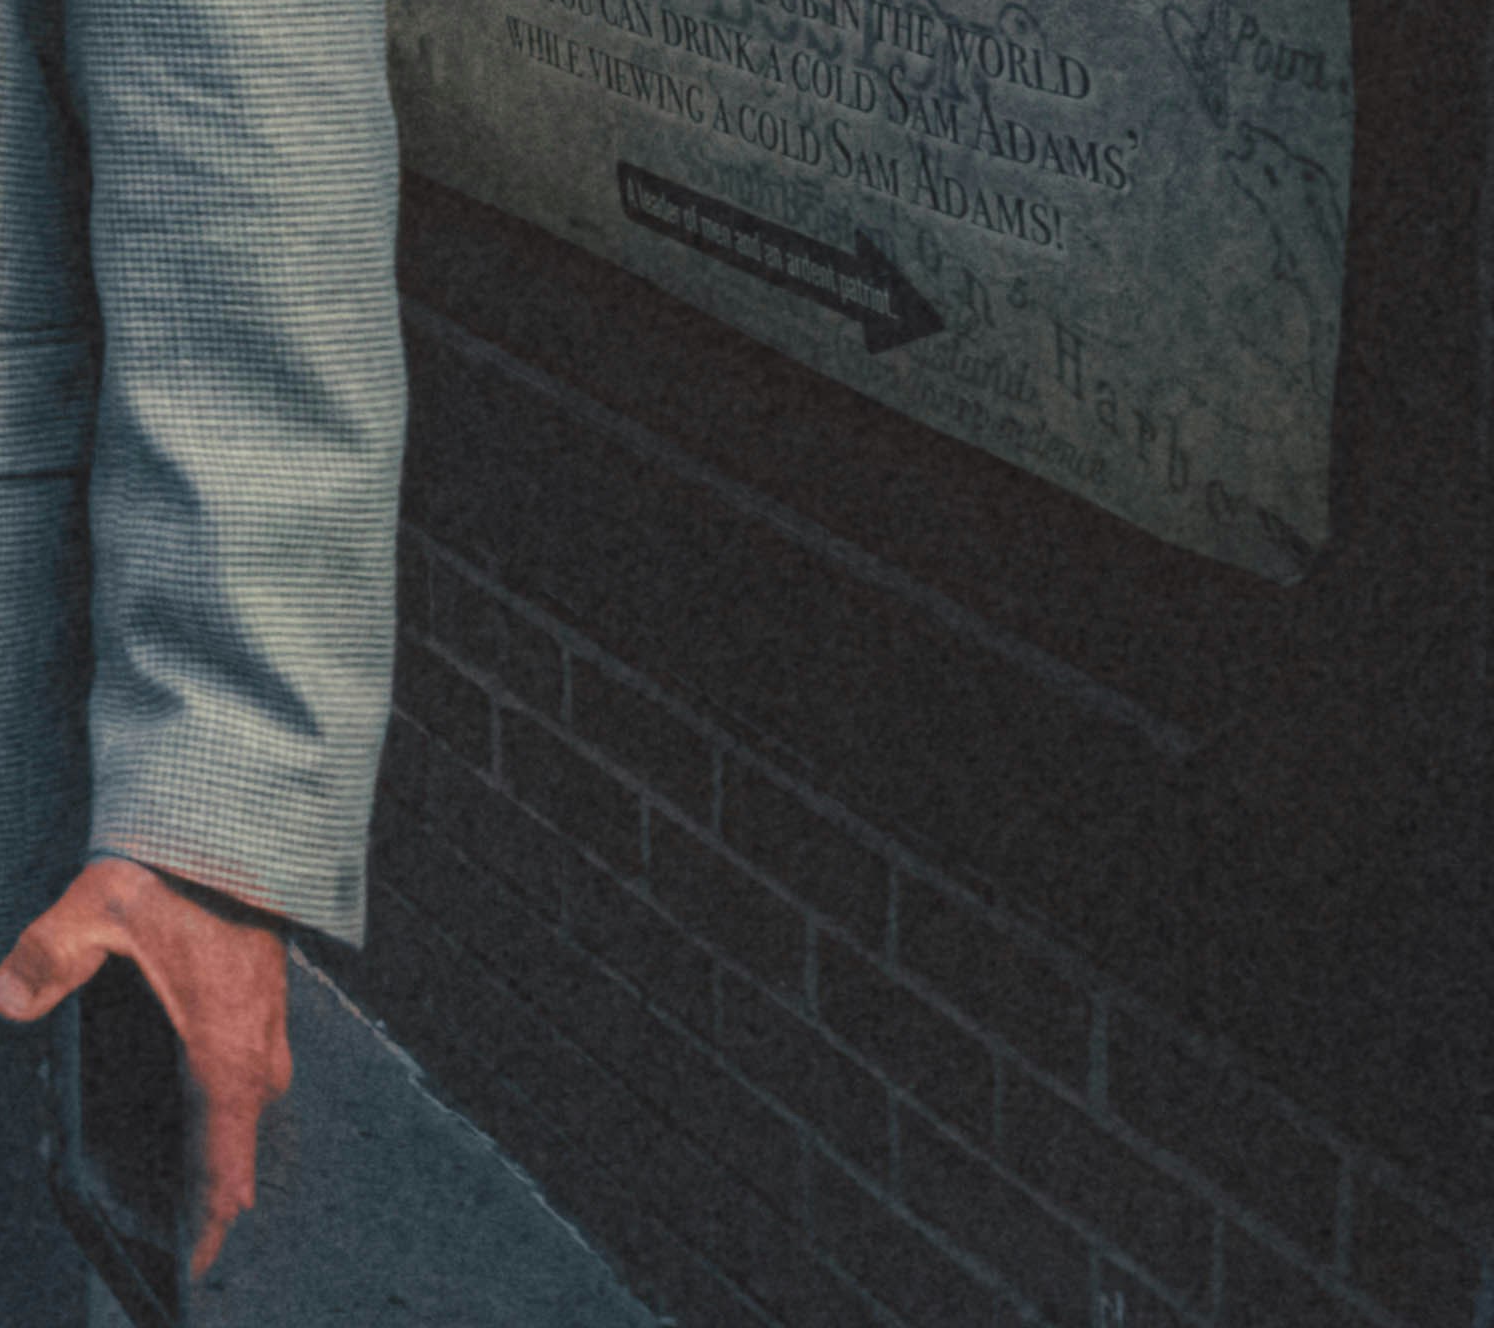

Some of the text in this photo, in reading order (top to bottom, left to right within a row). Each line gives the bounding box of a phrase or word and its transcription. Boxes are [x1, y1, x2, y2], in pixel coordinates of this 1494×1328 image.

[661, 8, 759, 76] DRINK
[766, 43, 784, 83] A
[790, 49, 876, 115] COLD
[887, 60, 960, 146] SAM
[875, 0, 936, 60] THE
[945, 23, 1091, 101] WORLD
[504, 13, 585, 79] WHILE
[589, 42, 706, 125] VIEWING
[713, 97, 732, 136] A
[736, 100, 823, 167] COLD
[828, 116, 899, 198] SAM
[915, 146, 1066, 251] ADAMS!
[785, 250, 836, 293] ardent
